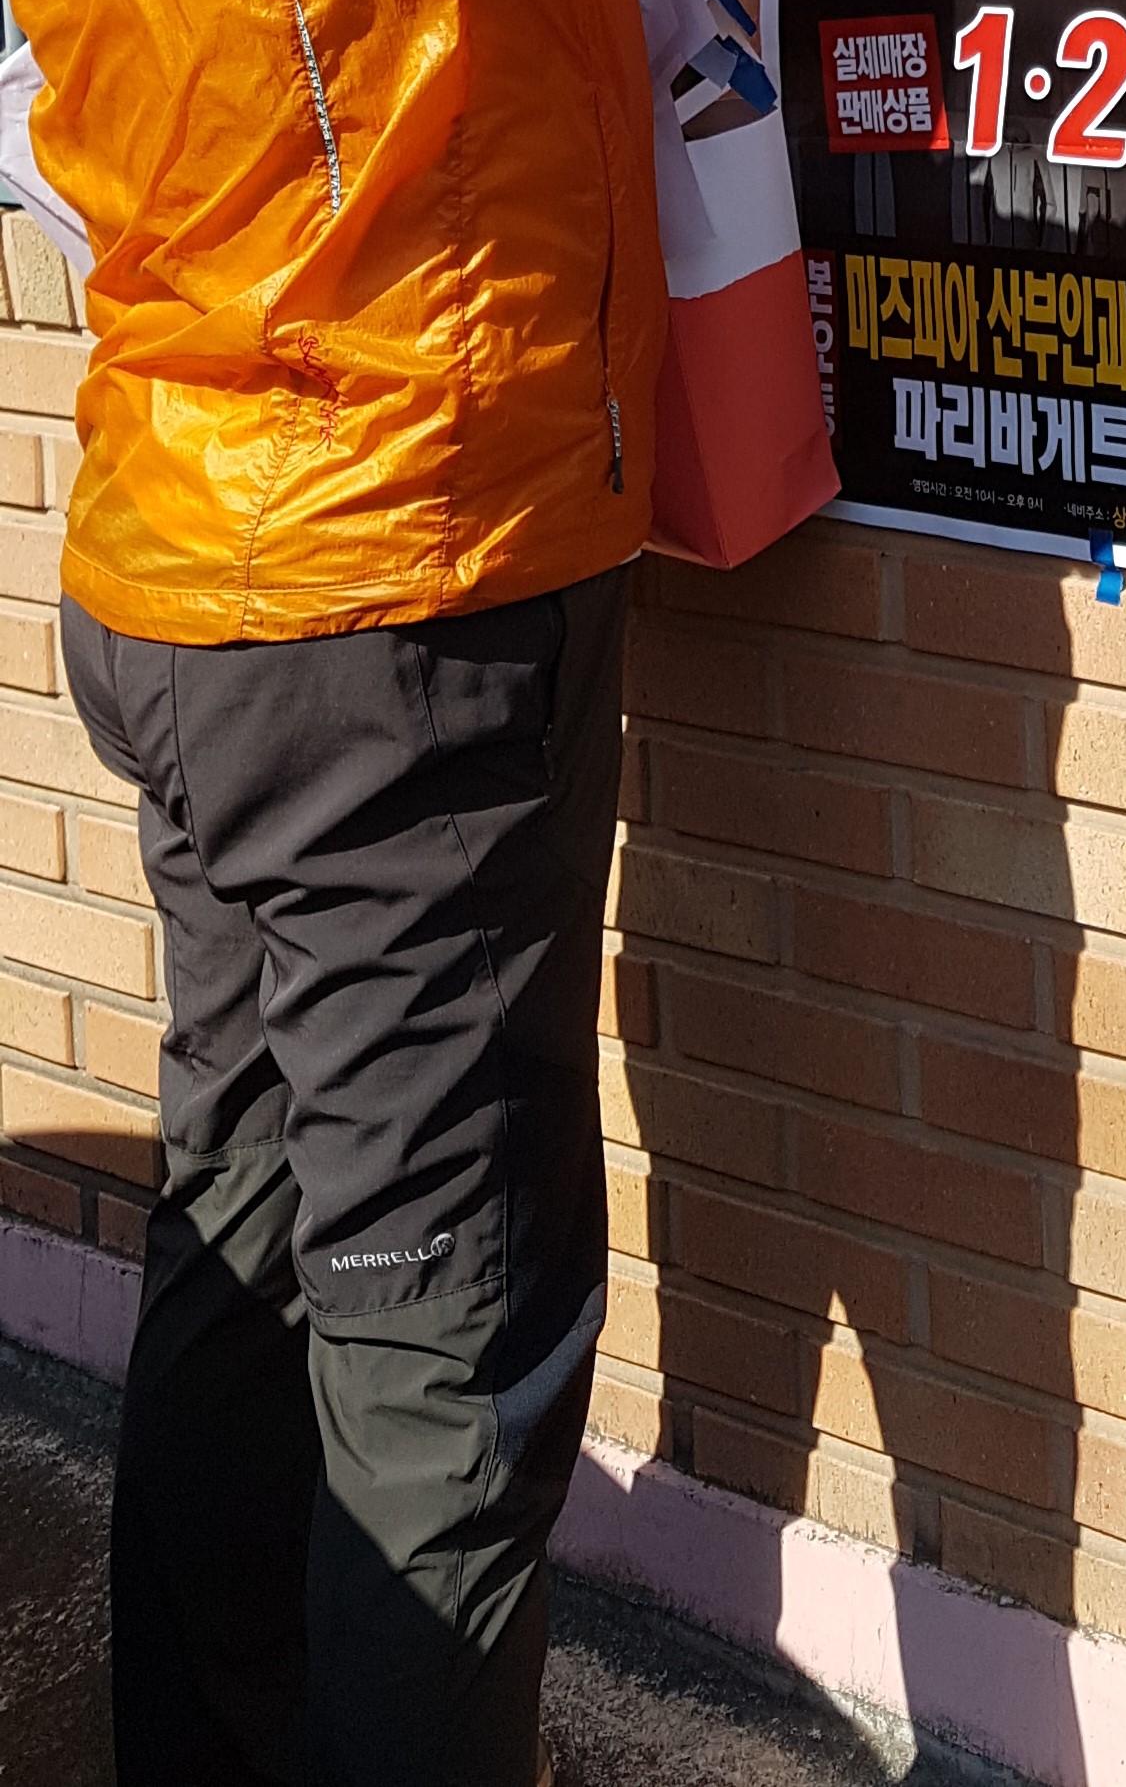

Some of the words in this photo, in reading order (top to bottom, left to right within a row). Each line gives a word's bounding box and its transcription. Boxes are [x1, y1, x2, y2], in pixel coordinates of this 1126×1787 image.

[832, 32, 928, 82] 실제매장
[835, 87, 932, 135] 판매상품
[845, 254, 979, 373] 미즈피아
[954, 486, 972, 501] 오전
[975, 489, 995, 504] 10시
[1007, 494, 1025, 508] 오후
[331, 1247, 432, 1273] MERRELL
